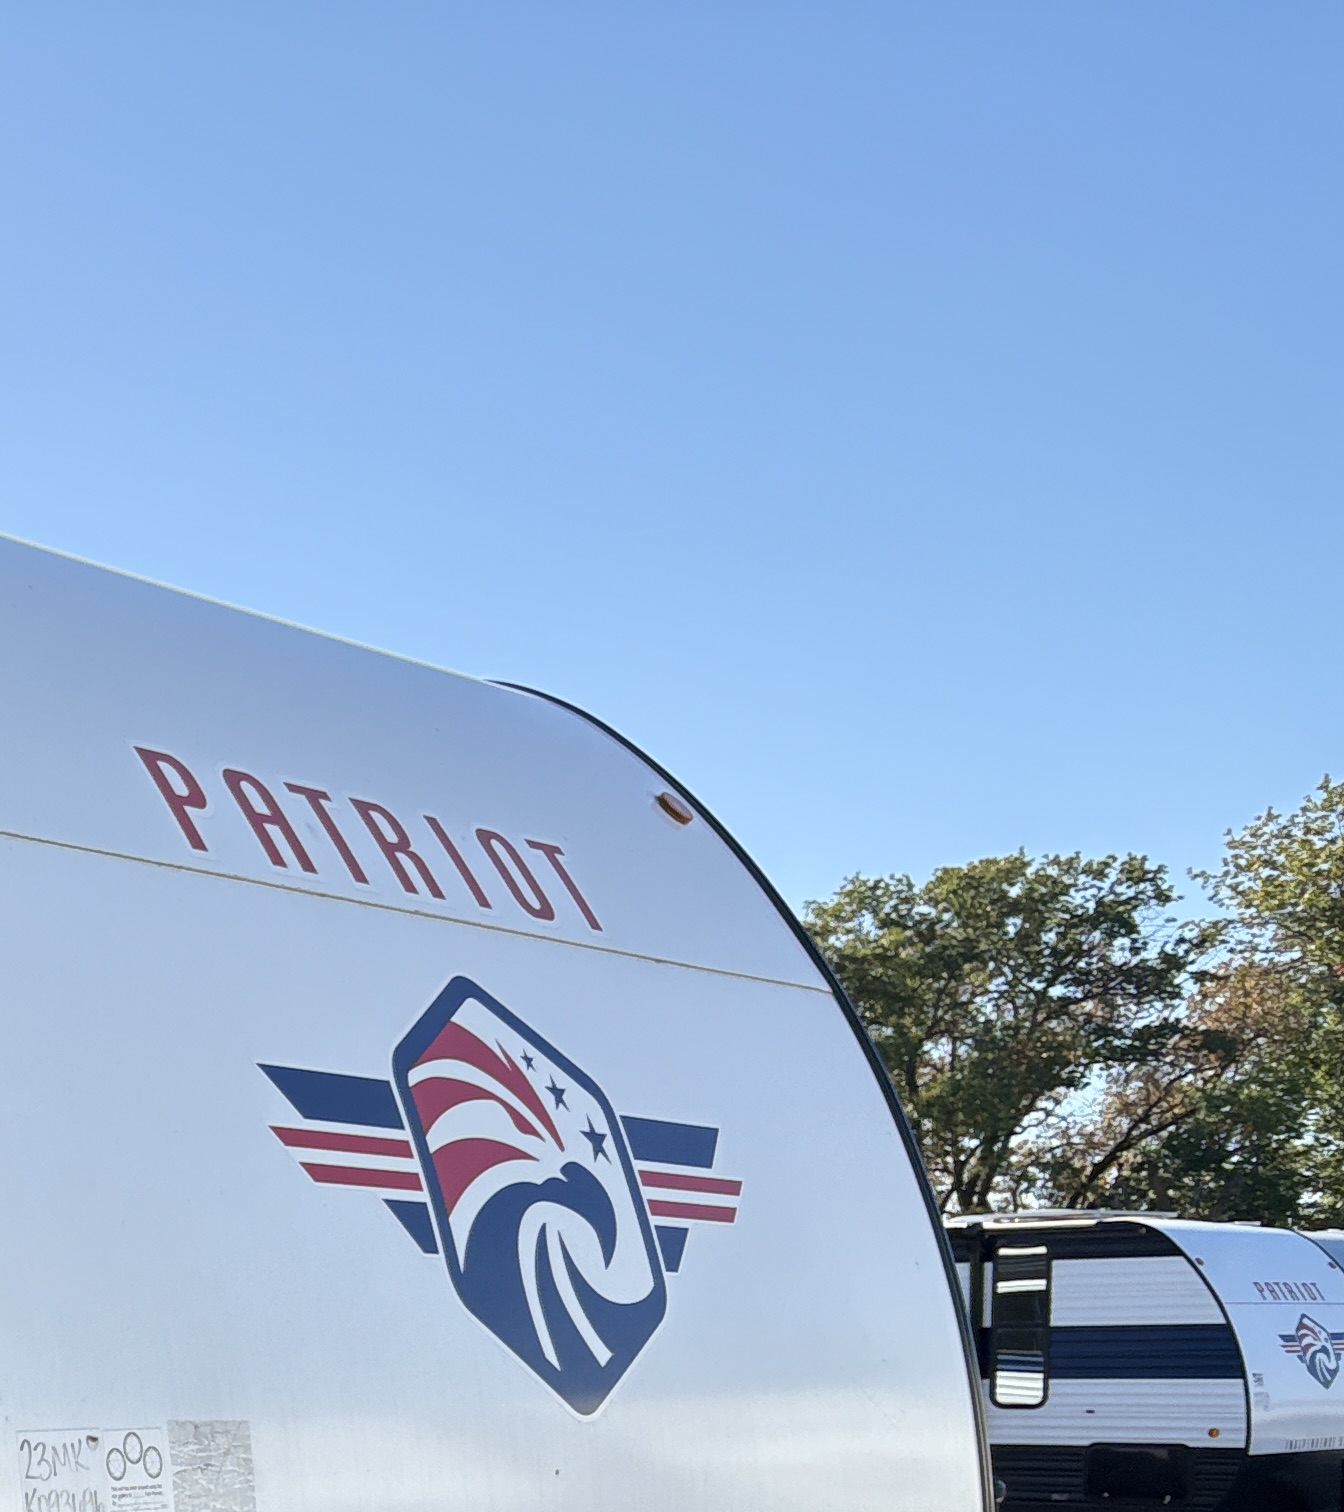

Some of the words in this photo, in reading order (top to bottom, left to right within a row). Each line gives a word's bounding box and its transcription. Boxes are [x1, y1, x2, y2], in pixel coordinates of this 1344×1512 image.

[133, 746, 604, 932] PATRIOT
[1252, 1281, 1326, 1301] PATRIOT
[19, 1438, 90, 1481] 23MK
